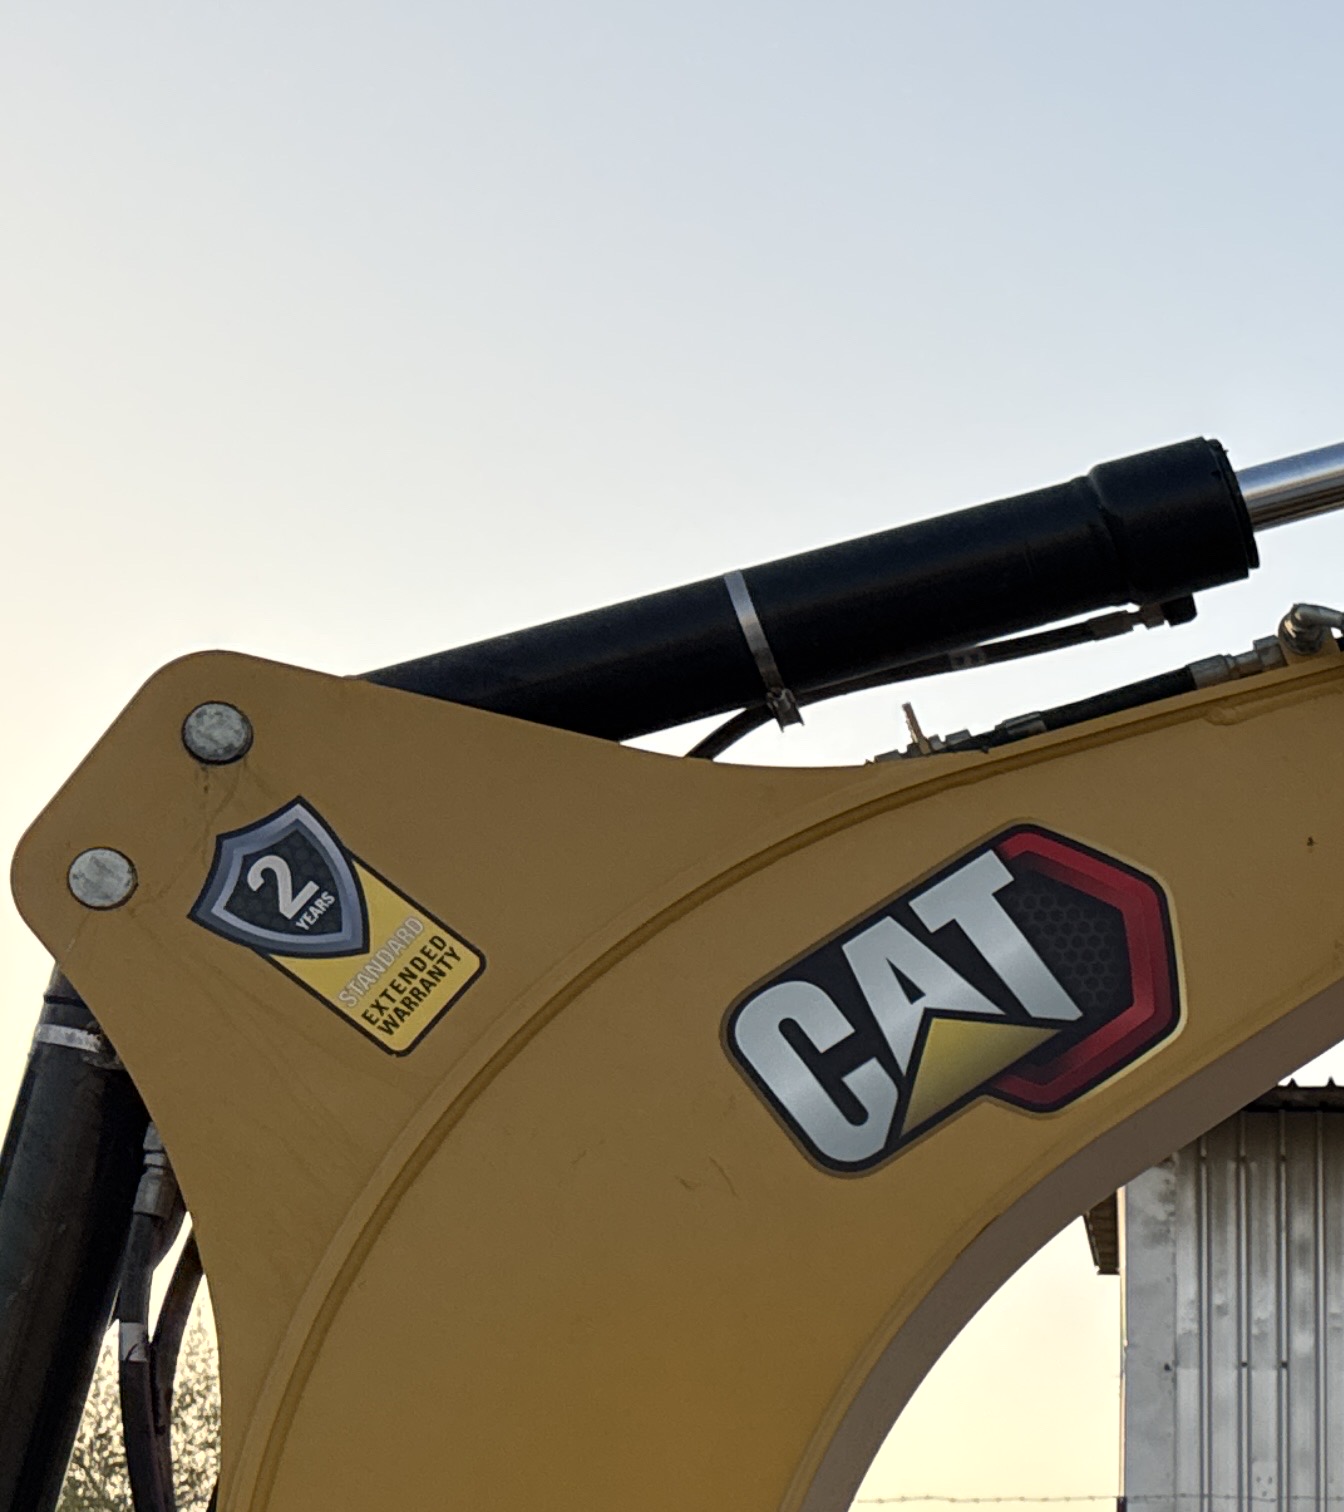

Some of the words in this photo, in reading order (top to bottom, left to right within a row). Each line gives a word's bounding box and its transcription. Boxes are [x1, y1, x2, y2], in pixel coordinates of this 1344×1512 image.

[246, 854, 321, 920] 2
[295, 891, 336, 932] YEARS
[337, 916, 425, 1008] STANDARD
[361, 934, 448, 1027] EXTENDED
[376, 946, 463, 1037] WARRANTY
[734, 848, 1084, 1163] CAT
